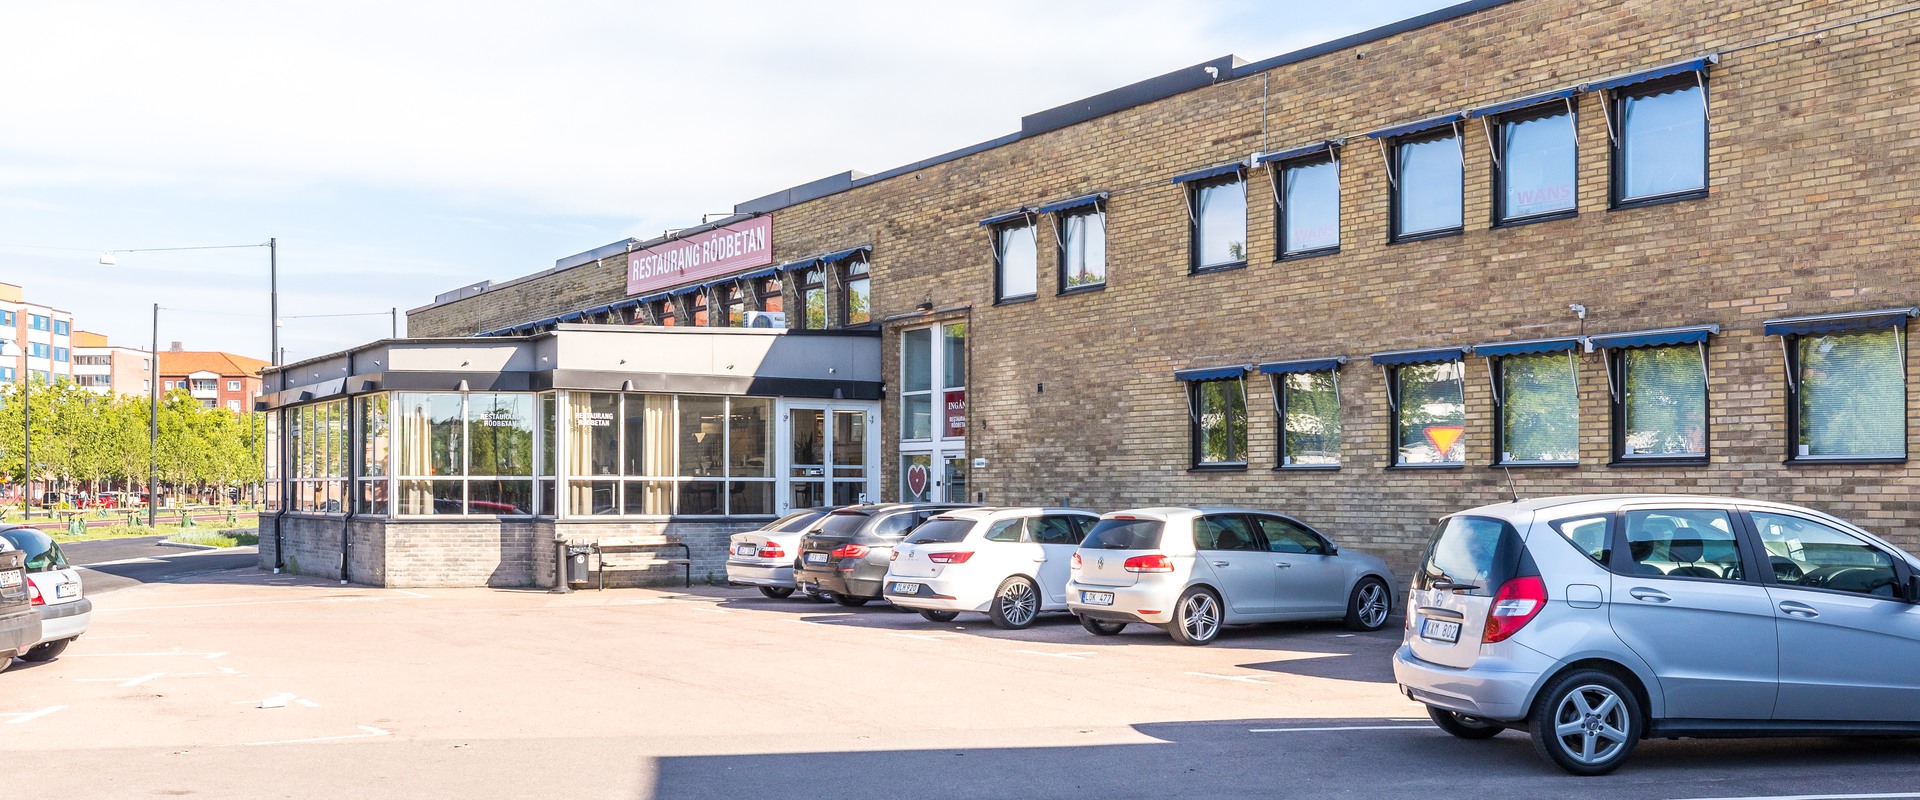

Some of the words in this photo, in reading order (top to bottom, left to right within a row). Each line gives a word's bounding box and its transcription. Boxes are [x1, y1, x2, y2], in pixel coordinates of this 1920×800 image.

[1517, 185, 1570, 204] WANS
[633, 244, 700, 280] RESTAURANG
[702, 226, 765, 263] RÖDBETAN
[1442, 624, 1456, 638] 802
